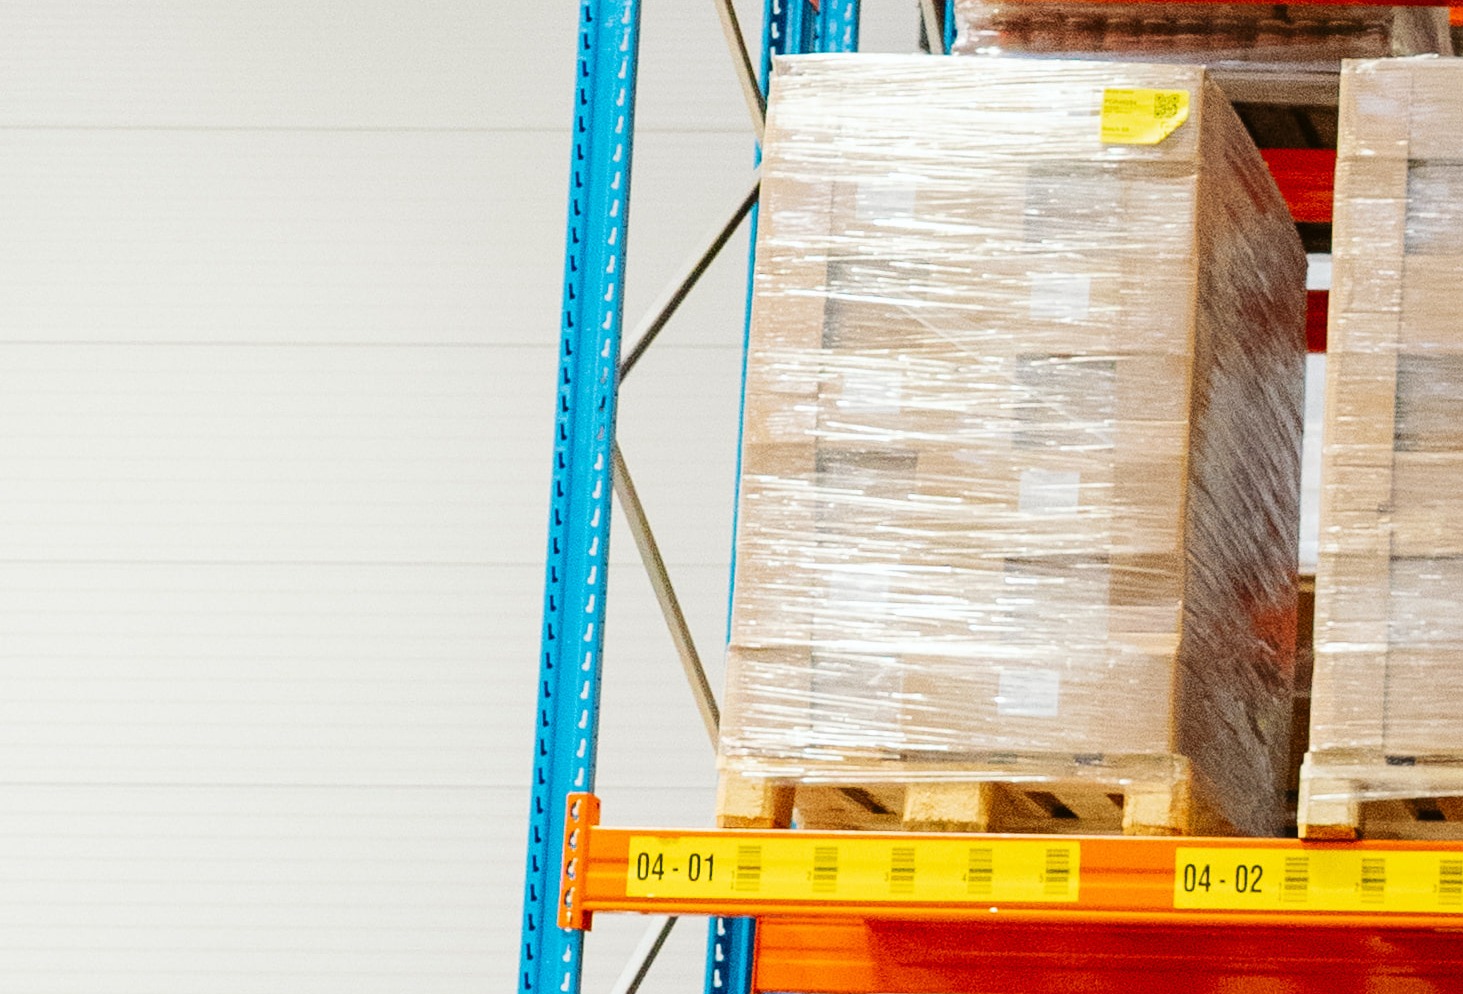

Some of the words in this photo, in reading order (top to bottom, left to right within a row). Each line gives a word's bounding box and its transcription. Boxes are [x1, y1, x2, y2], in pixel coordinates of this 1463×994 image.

[637, 852, 665, 881] 04
[688, 853, 714, 882] 01
[1184, 864, 1211, 892] 04
[1235, 864, 1263, 893] 02
